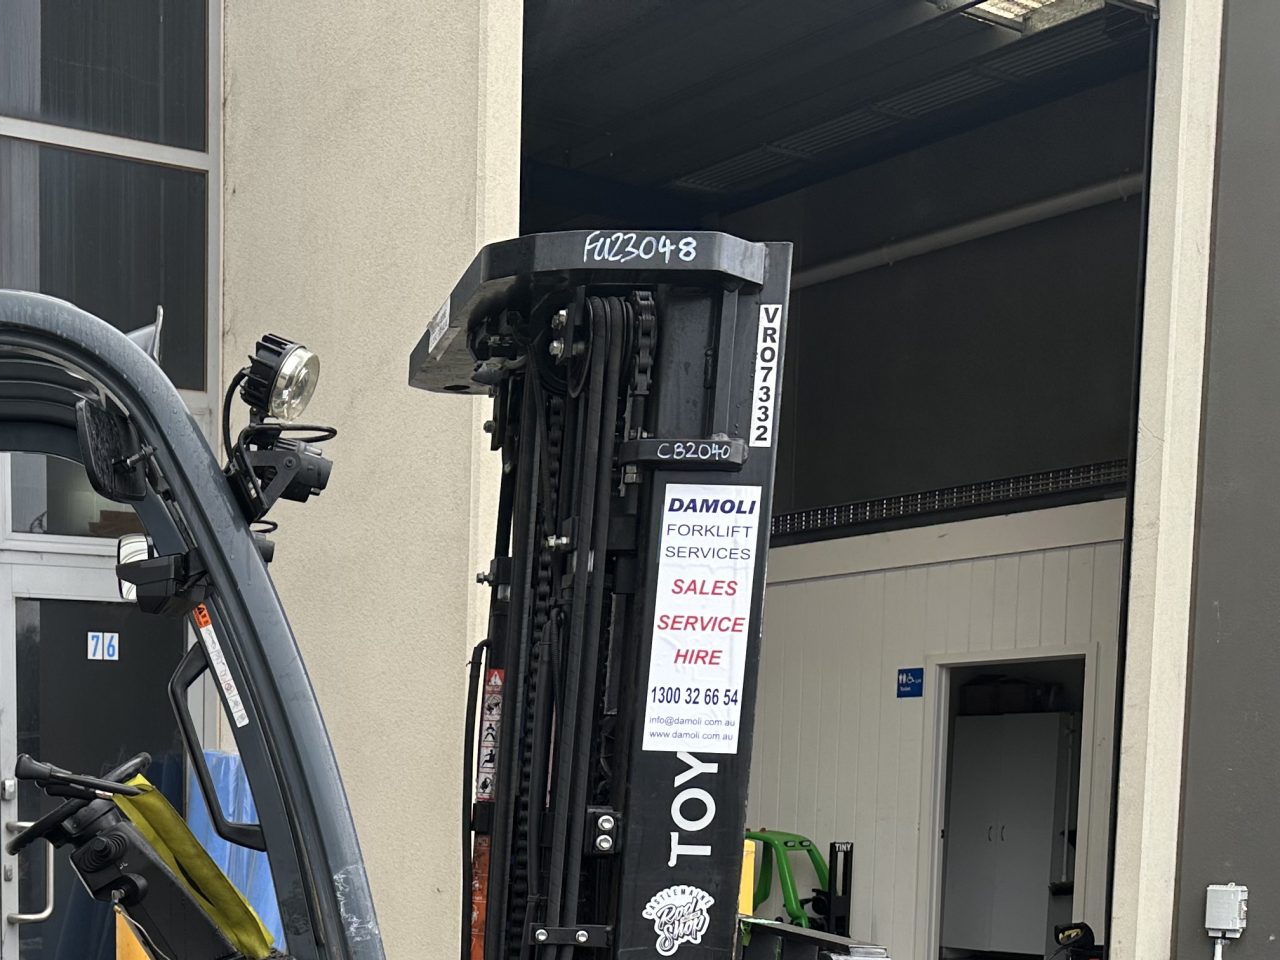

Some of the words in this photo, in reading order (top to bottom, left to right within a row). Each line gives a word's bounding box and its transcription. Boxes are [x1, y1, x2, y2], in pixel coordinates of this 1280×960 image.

[668, 498, 757, 515] DAMOLI
[666, 523, 753, 538] FORKLIFT
[665, 546, 751, 560] SERVICES
[671, 578, 738, 596] SALES
[657, 614, 746, 633] SERVICE
[673, 649, 723, 665] HIRE
[651, 686, 681, 704] 1300
[685, 687, 700, 705] 32
[704, 688, 719, 706] 66
[723, 689, 739, 706] 54
[834, 843, 852, 852] TINY
[645, 888, 712, 917] CASTLEMAINE
